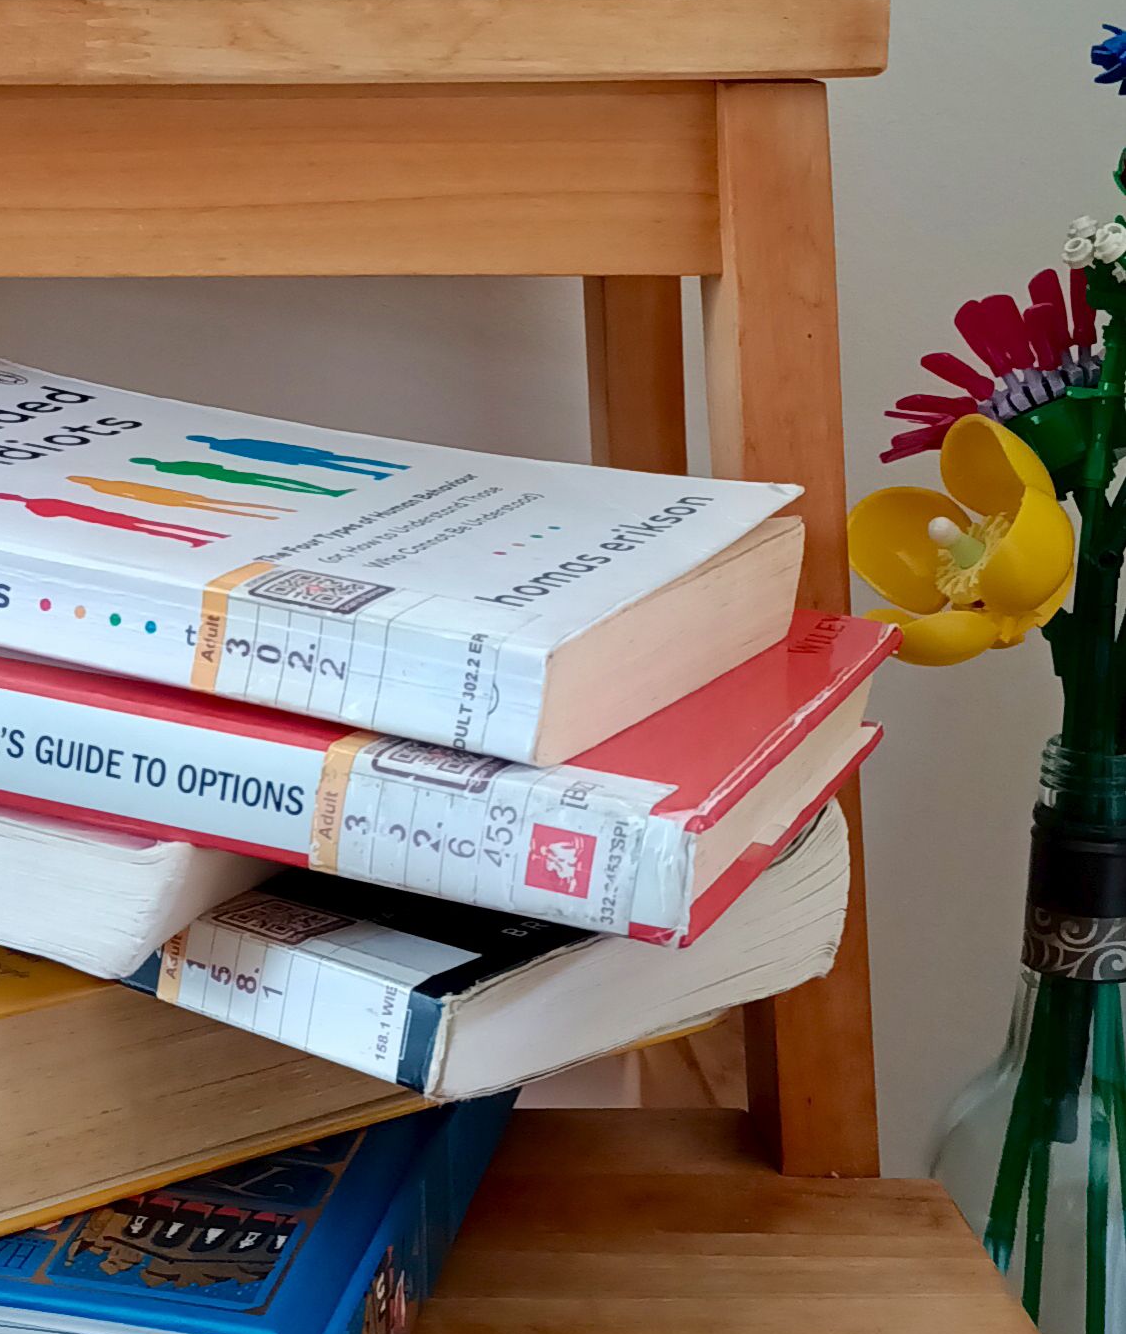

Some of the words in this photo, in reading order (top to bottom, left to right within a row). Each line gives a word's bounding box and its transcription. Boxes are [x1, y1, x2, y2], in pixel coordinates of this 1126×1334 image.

[411, 472, 480, 501] Behaviour
[339, 537, 384, 555] How
[374, 530, 400, 543] to
[387, 500, 470, 534] Understand
[455, 485, 505, 505] Those
[357, 514, 379, 526] of
[367, 494, 426, 519] Human
[397, 531, 457, 556] Cannot
[441, 522, 473, 536] Be
[460, 492, 546, 527] Understood)
[280, 537, 325, 554] Four
[312, 522, 365, 540] Types
[473, 553, 613, 608] homas
[599, 494, 716, 553] erikson
[225, 637, 253, 658] 3
[256, 643, 283, 665] 0
[318, 656, 347, 681] 2
[452, 702, 474, 751] DULT
[34, 734, 123, 782] GUIDE
[131, 752, 168, 789] TO
[176, 763, 305, 818] OPTIONS
[317, 789, 340, 841] Adult
[447, 836, 476, 860] 6
[210, 964, 234, 987] 5
[262, 983, 285, 1001] 1
[381, 984, 399, 1017] WIE
[374, 1020, 392, 1062] 158.1
